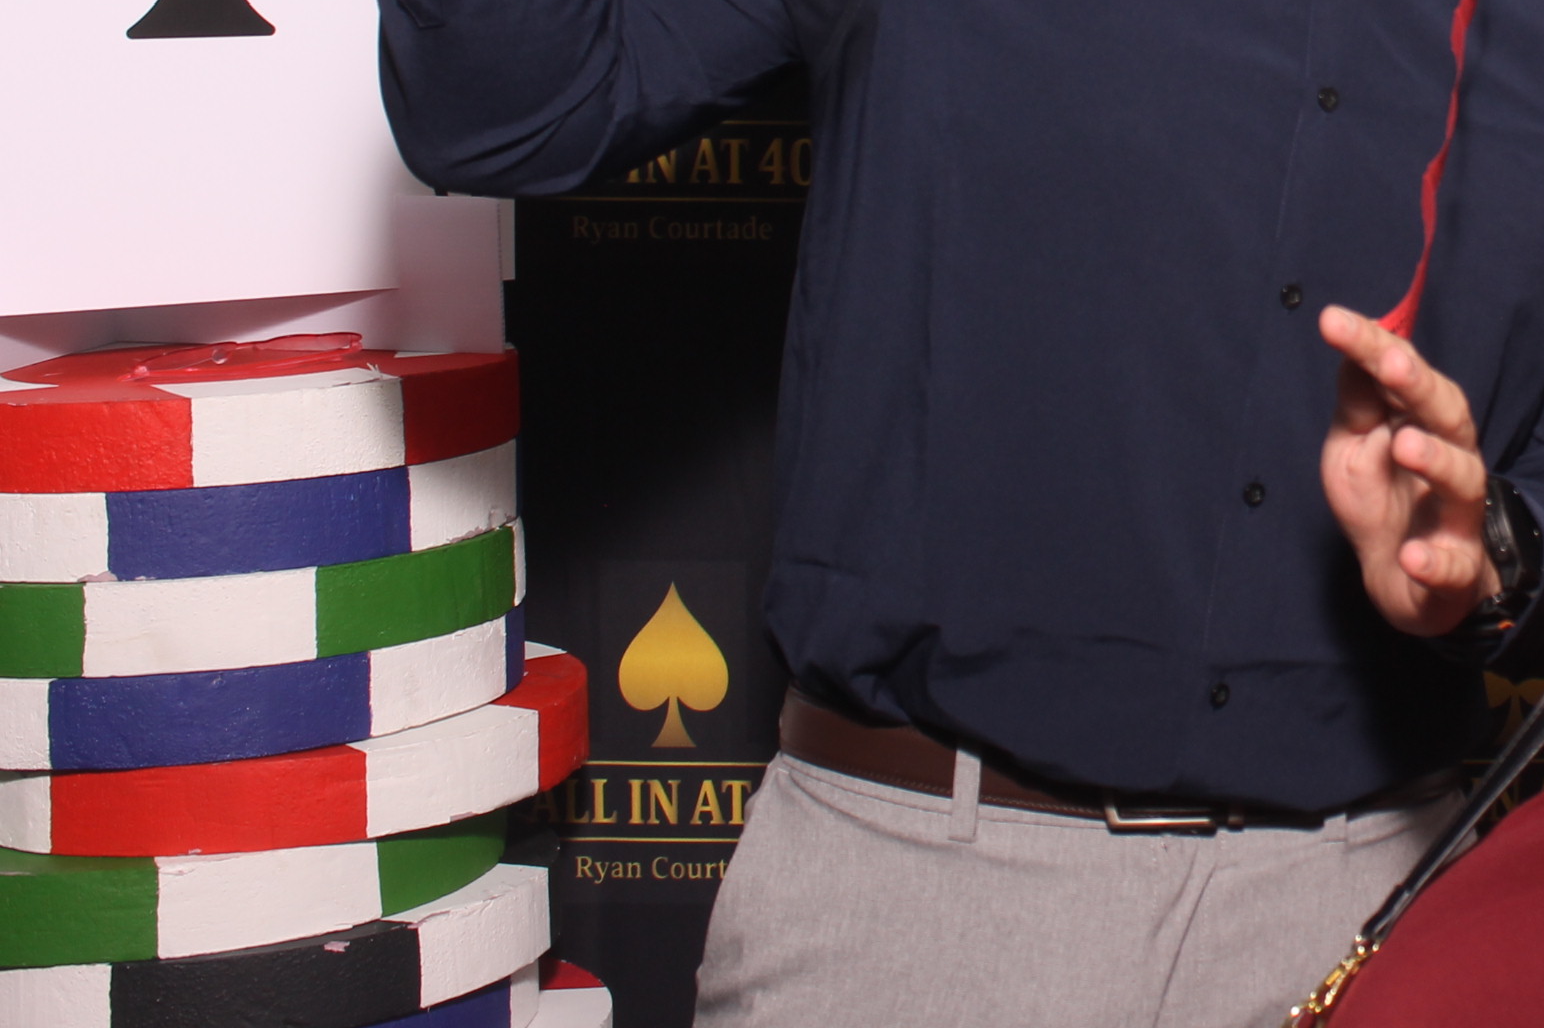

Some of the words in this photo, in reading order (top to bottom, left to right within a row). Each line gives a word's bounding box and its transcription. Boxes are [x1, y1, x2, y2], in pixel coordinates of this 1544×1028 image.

[689, 137, 749, 185] AT
[758, 137, 813, 187] 40
[571, 215, 639, 244] Ryan
[648, 216, 774, 241] Courtade
[627, 779, 682, 825] IN
[689, 779, 753, 826] AT
[575, 855, 642, 884] Ryan
[651, 856, 727, 881] Court
